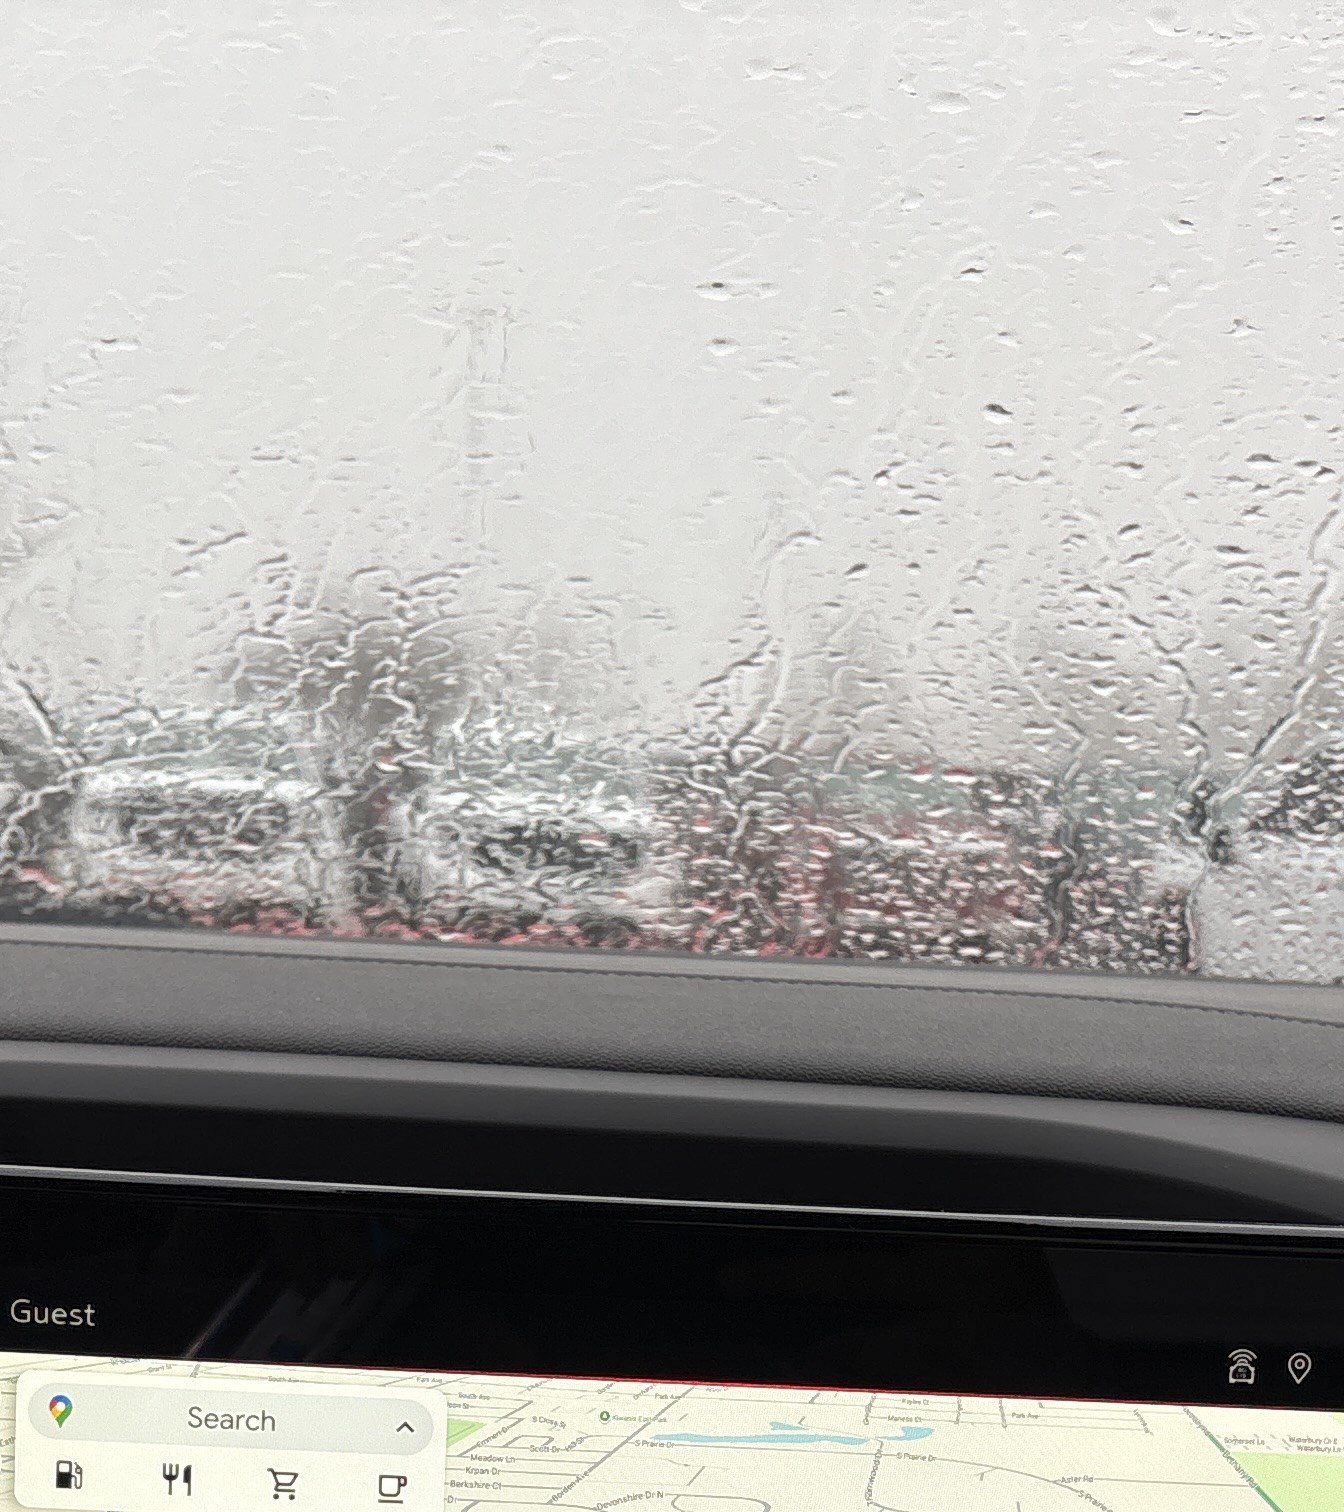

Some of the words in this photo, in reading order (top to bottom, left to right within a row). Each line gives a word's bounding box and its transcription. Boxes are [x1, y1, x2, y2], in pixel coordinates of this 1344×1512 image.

[10, 1298, 96, 1329] Guest
[187, 1406, 277, 1434] Search
[470, 1453, 504, 1462] Meadow
[506, 1455, 516, 1463] Ln
[596, 1492, 644, 1511] Devonshire
[645, 1491, 655, 1500] Dr
[657, 1490, 664, 1499] N
